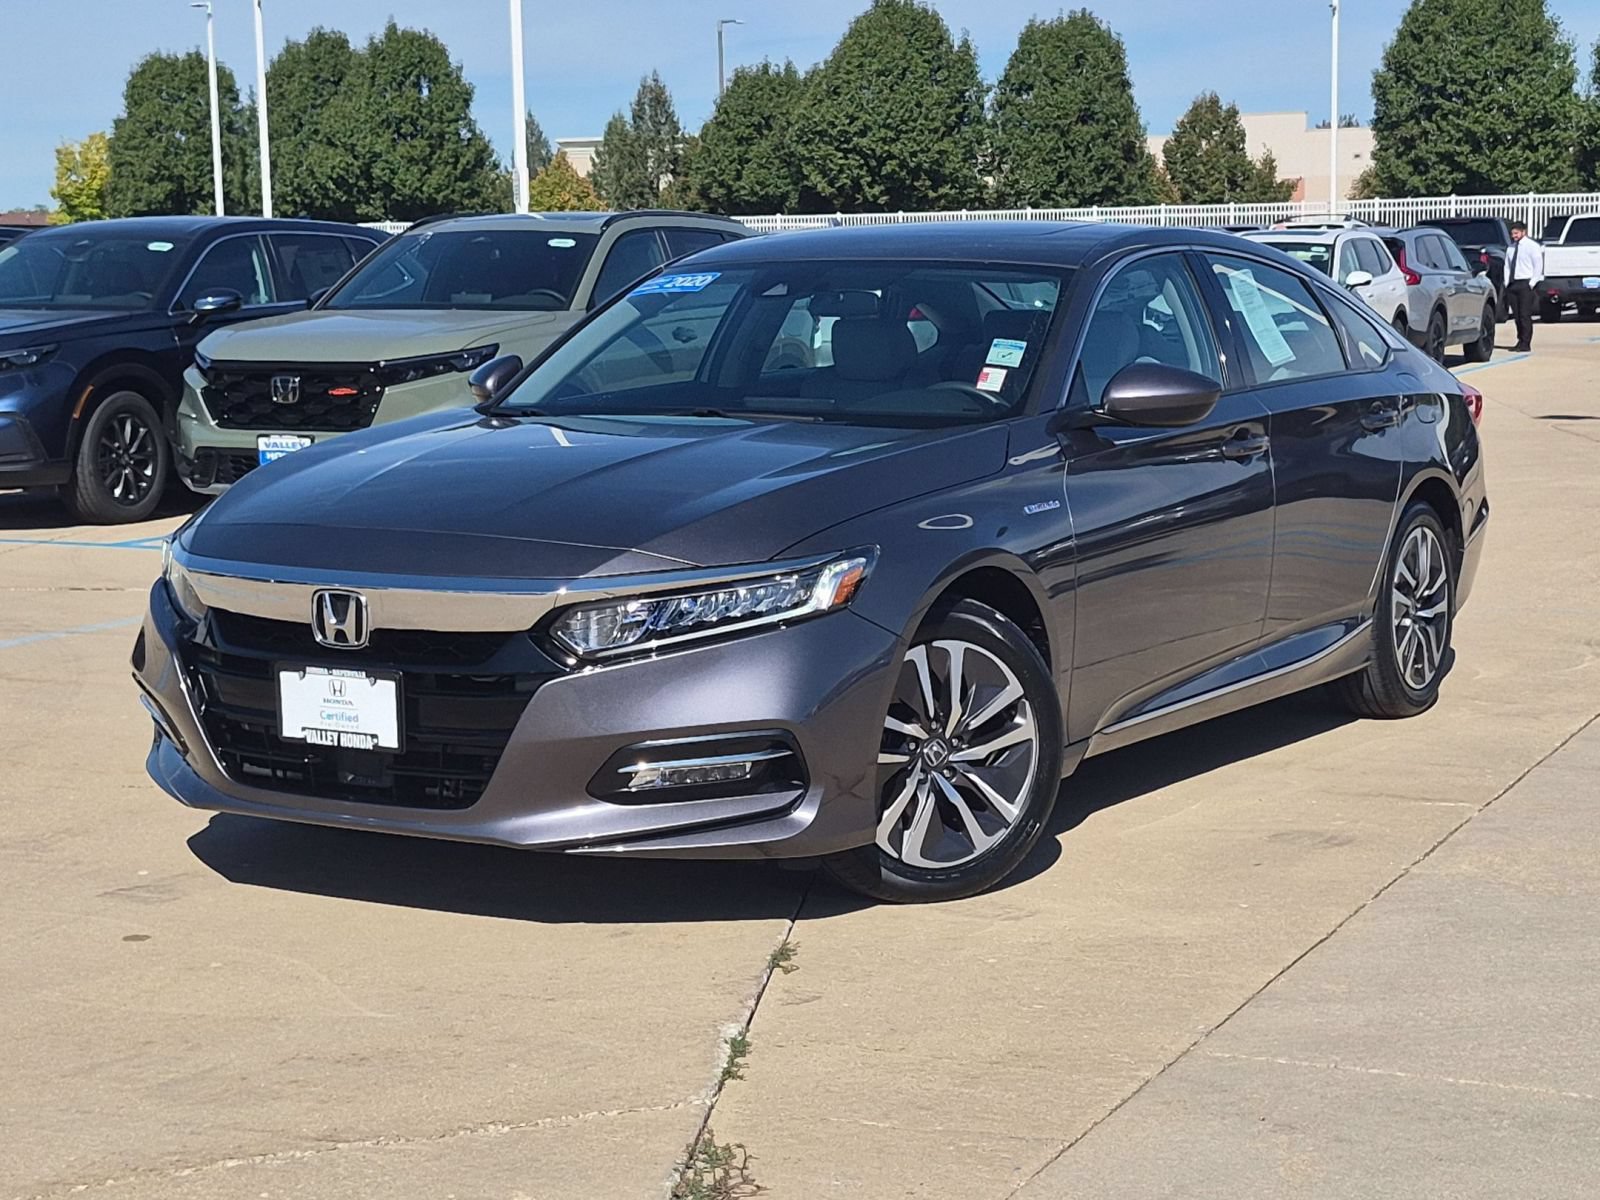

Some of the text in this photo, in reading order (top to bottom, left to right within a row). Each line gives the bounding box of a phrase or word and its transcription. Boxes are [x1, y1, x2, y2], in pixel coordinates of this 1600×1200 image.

[263, 441, 306, 449] VALLEY
[323, 698, 354, 706] HONDA
[320, 710, 359, 722] Certified
[305, 728, 374, 750] VALLEY HONDA
